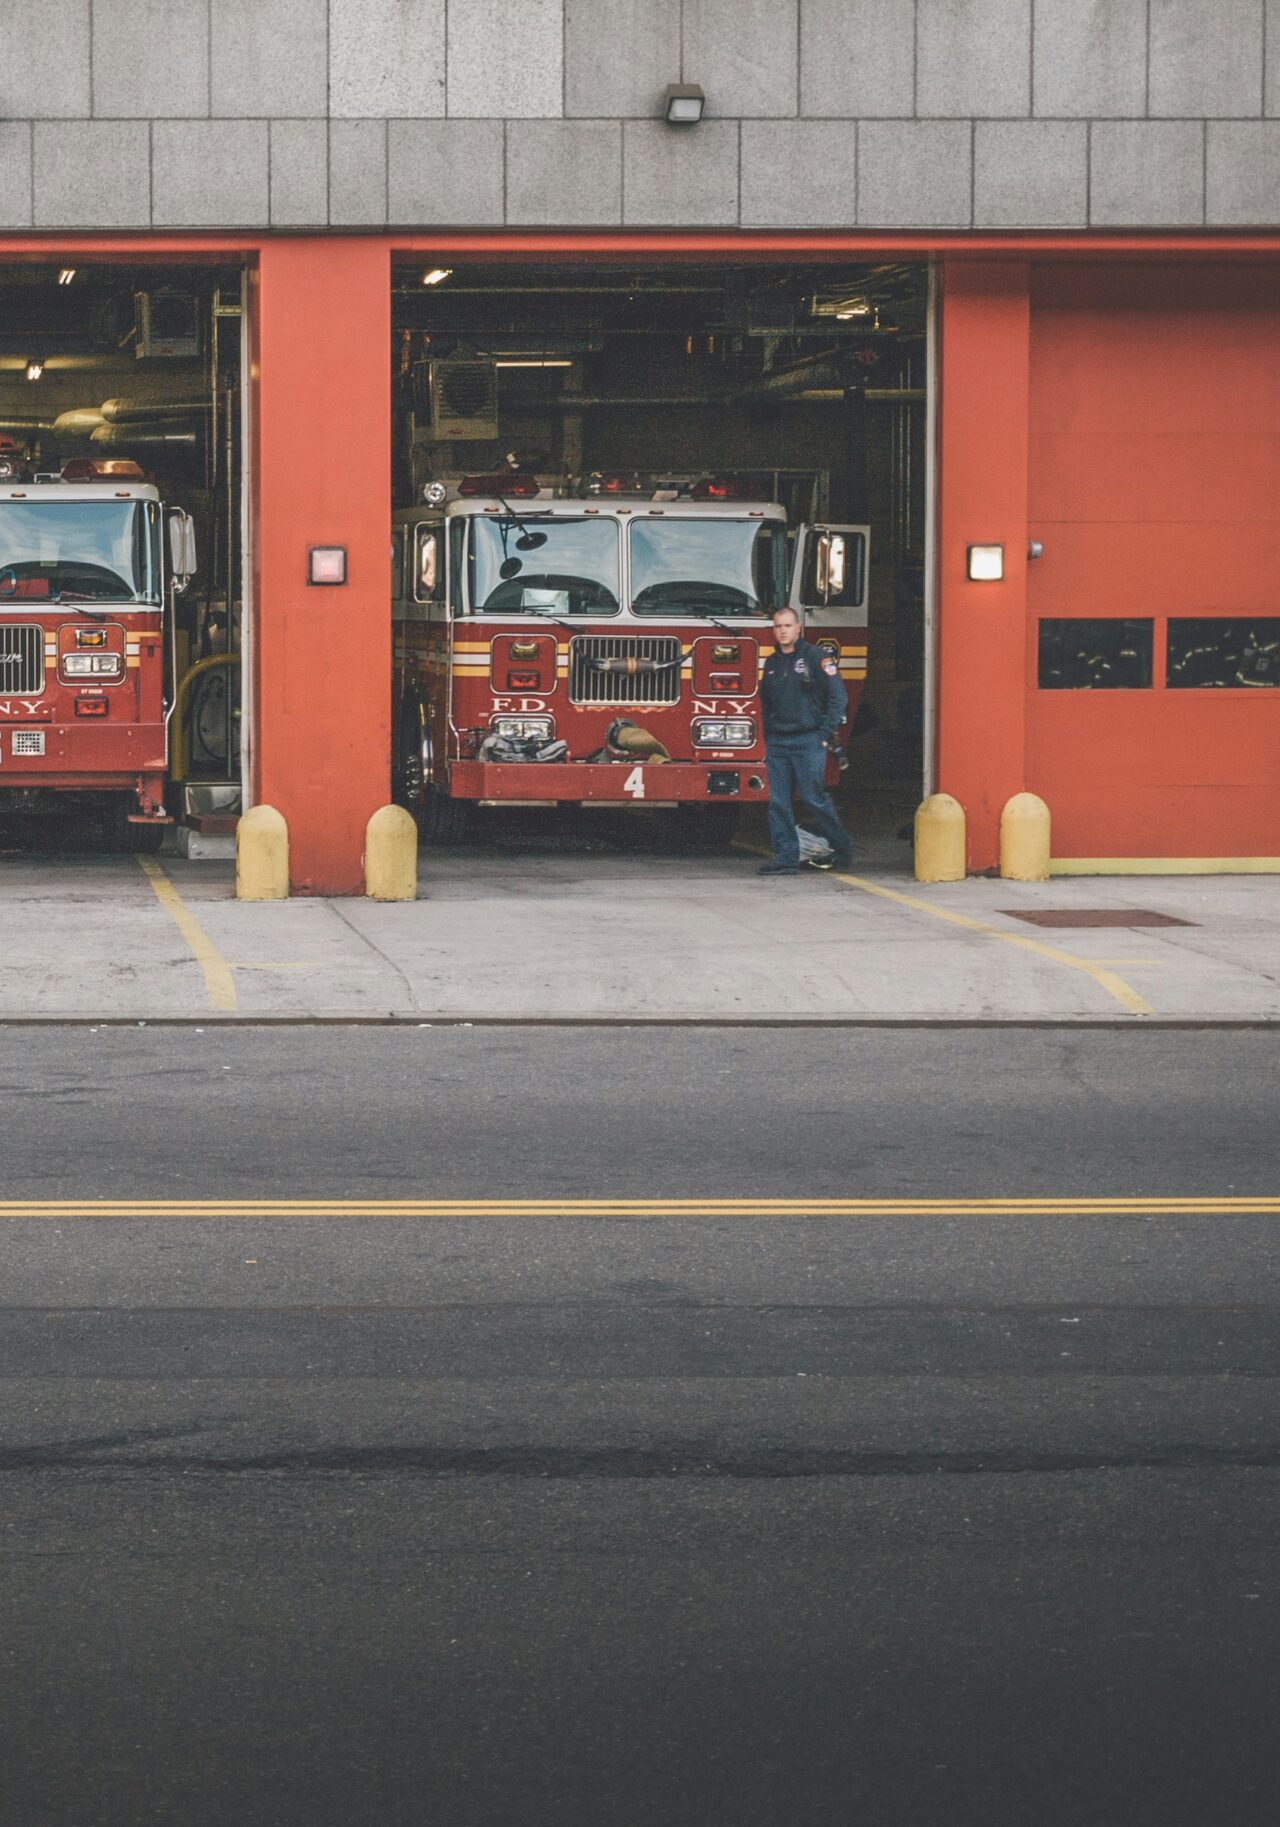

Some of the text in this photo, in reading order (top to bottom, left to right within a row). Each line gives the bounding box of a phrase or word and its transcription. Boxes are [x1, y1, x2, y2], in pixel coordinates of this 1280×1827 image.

[491, 698, 757, 714] F.D. N.Y.
[624, 767, 644, 798] 4
